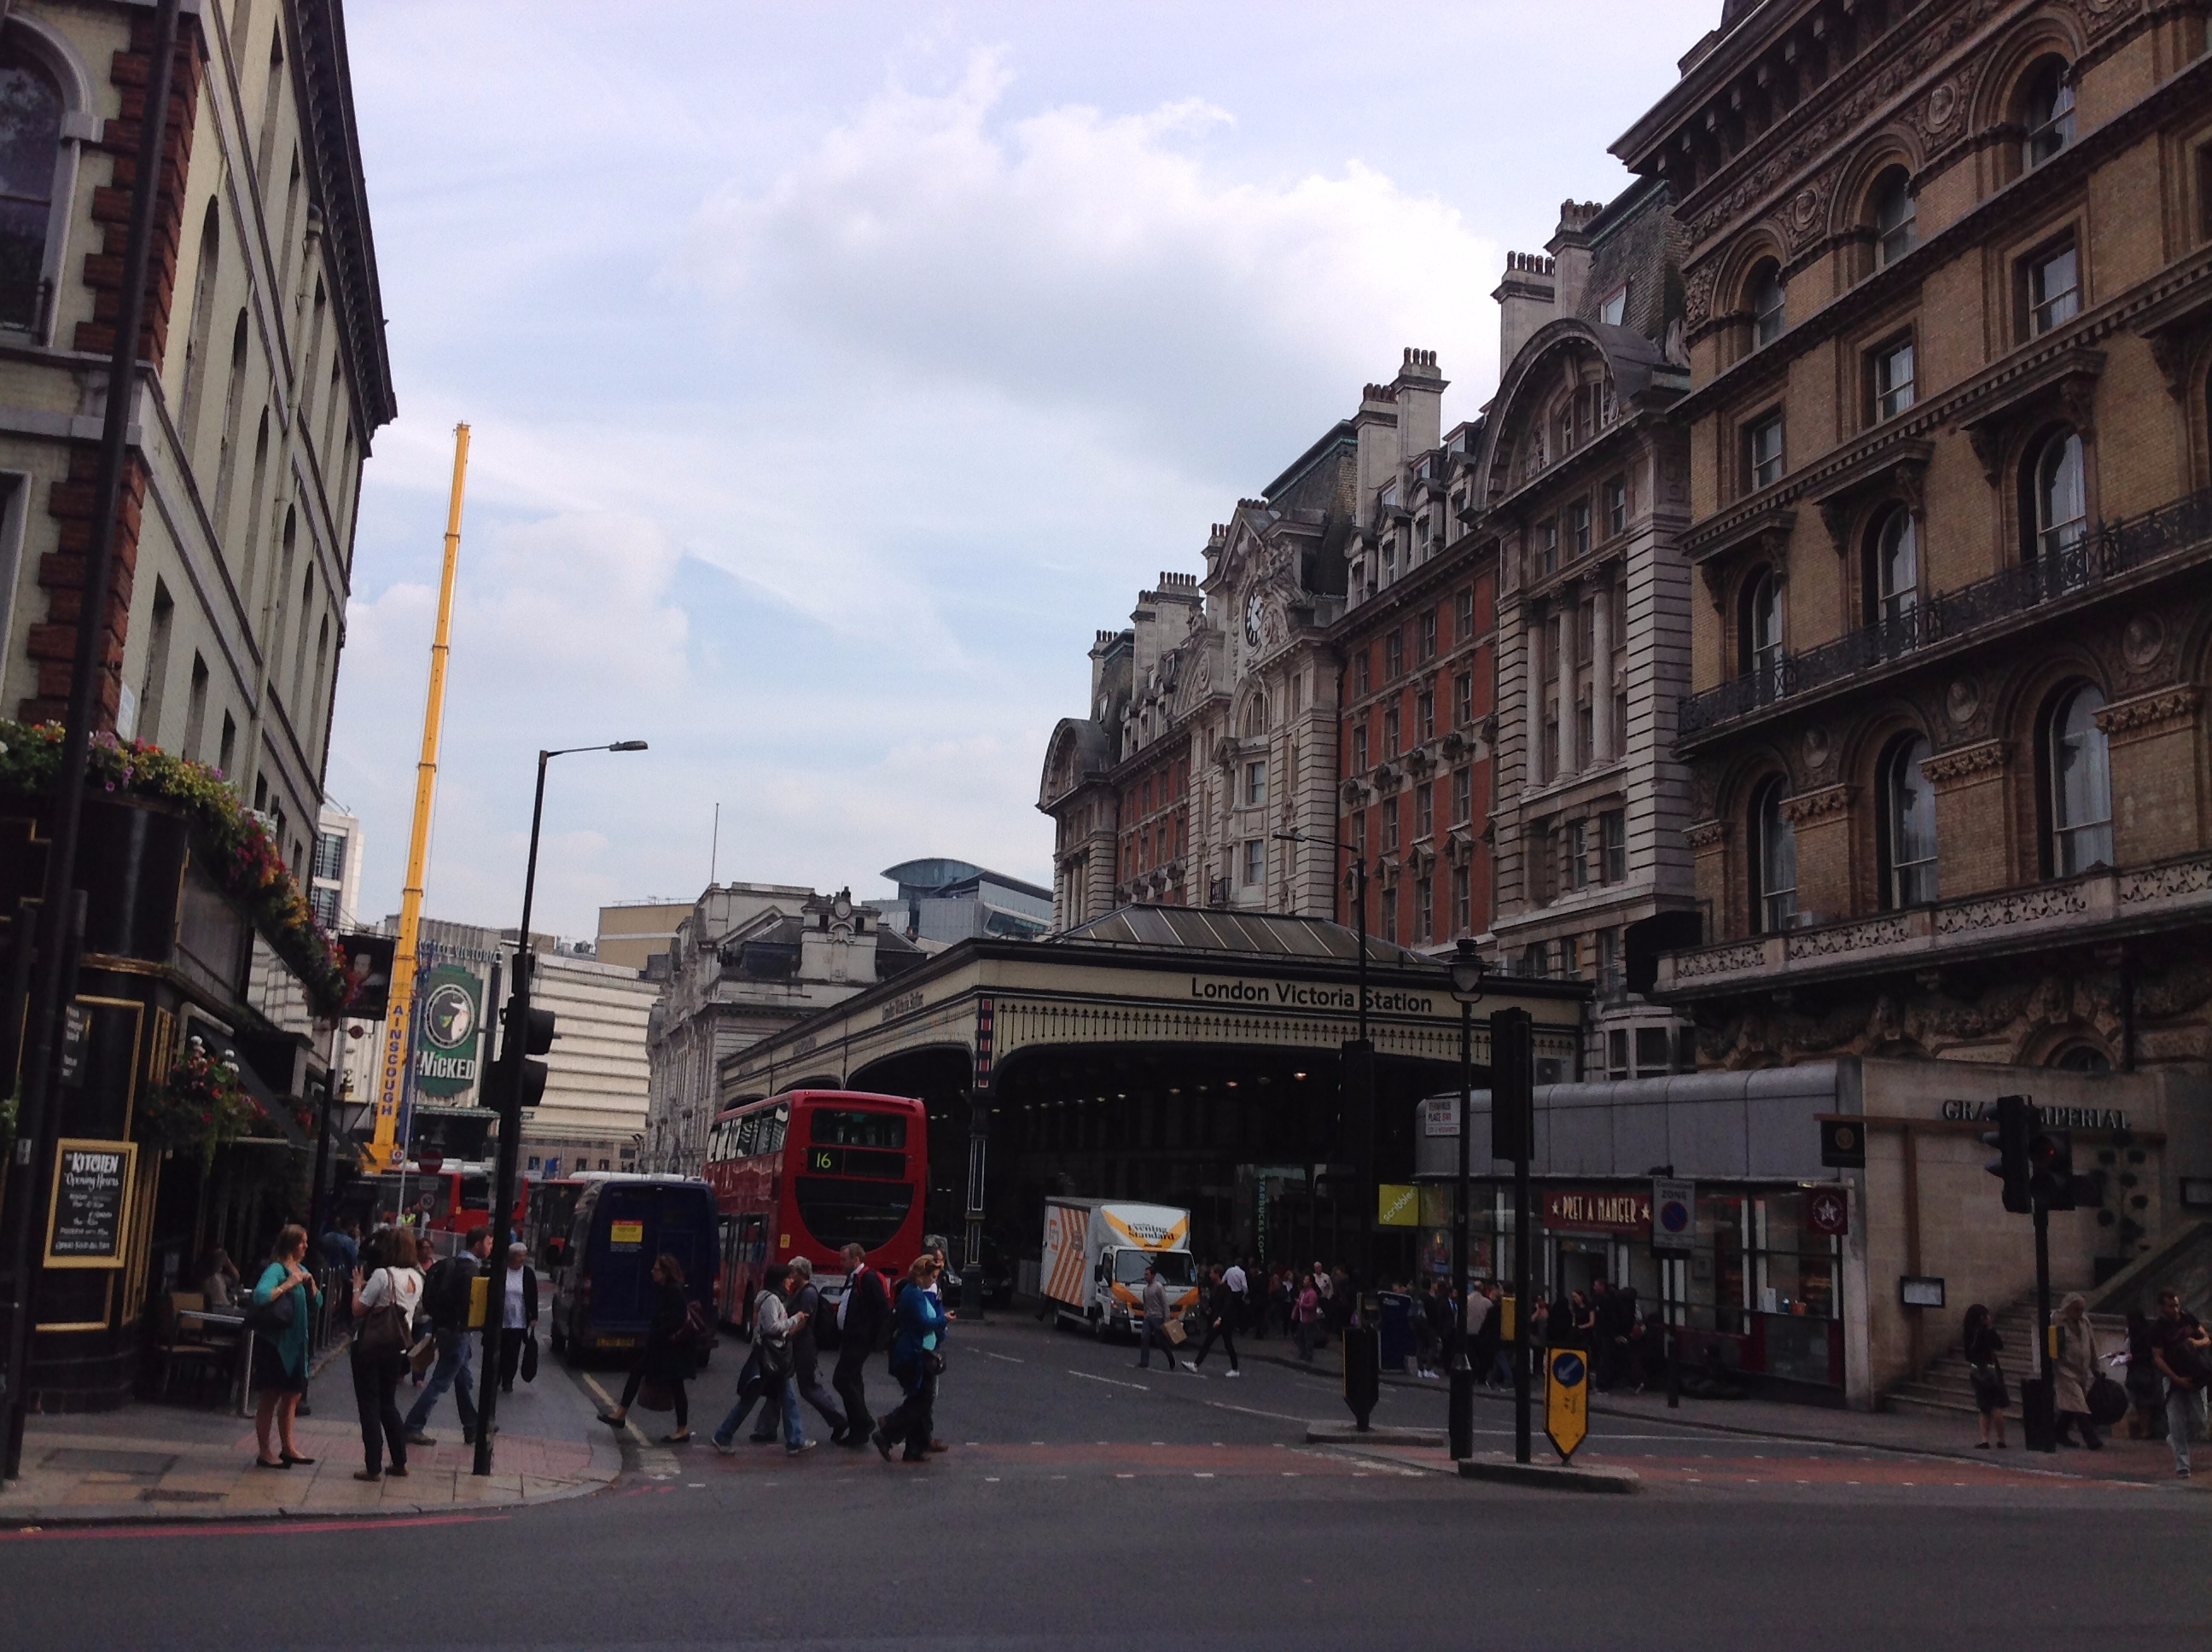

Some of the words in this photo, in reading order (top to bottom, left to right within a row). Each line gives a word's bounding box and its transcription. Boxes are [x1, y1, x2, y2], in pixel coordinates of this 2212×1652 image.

[455, 945, 498, 963] VICTORIA
[1191, 977, 1269, 1002] London
[1275, 982, 1354, 1008] Victoria
[1365, 988, 1432, 1013] Station
[381, 1004, 405, 1115] AINSCOUGH
[416, 1050, 476, 1081] WICKED
[2037, 1106, 2132, 1129] MPERIAL
[72, 1152, 119, 1173] KITCHEN
[816, 1152, 832, 1169] 16
[1257, 1173, 1266, 1232] STARBUCKS
[1382, 1188, 1416, 1222] scribbler
[1661, 1190, 1687, 1201] ZONE
[1563, 1195, 1584, 1220] PRET
[1587, 1197, 1594, 1221] A
[1598, 1197, 1637, 1224] MANGER
[1127, 1224, 1167, 1236] Evening
[1128, 1231, 1175, 1240] Standard
